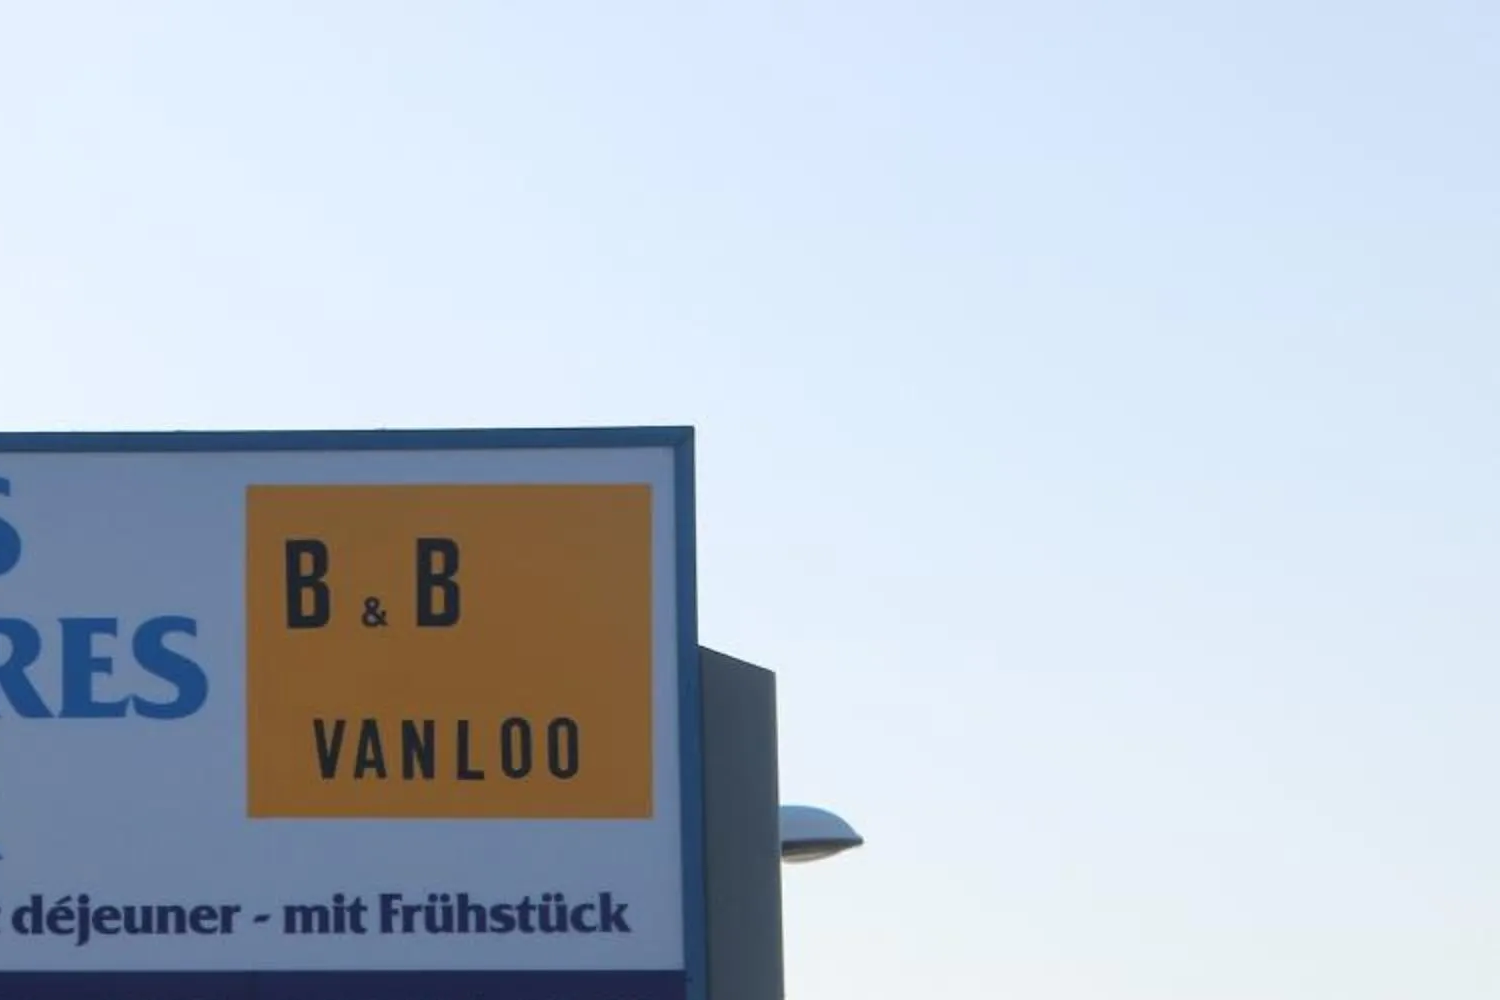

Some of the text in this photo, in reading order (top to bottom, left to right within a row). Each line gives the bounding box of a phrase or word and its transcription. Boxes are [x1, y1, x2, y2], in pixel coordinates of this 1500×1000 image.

[284, 537, 462, 629] B & B
[313, 716, 580, 781] VANLOO
[11, 893, 242, 947] déjeuner
[283, 892, 368, 935] mit
[379, 891, 632, 935] Frühstück
